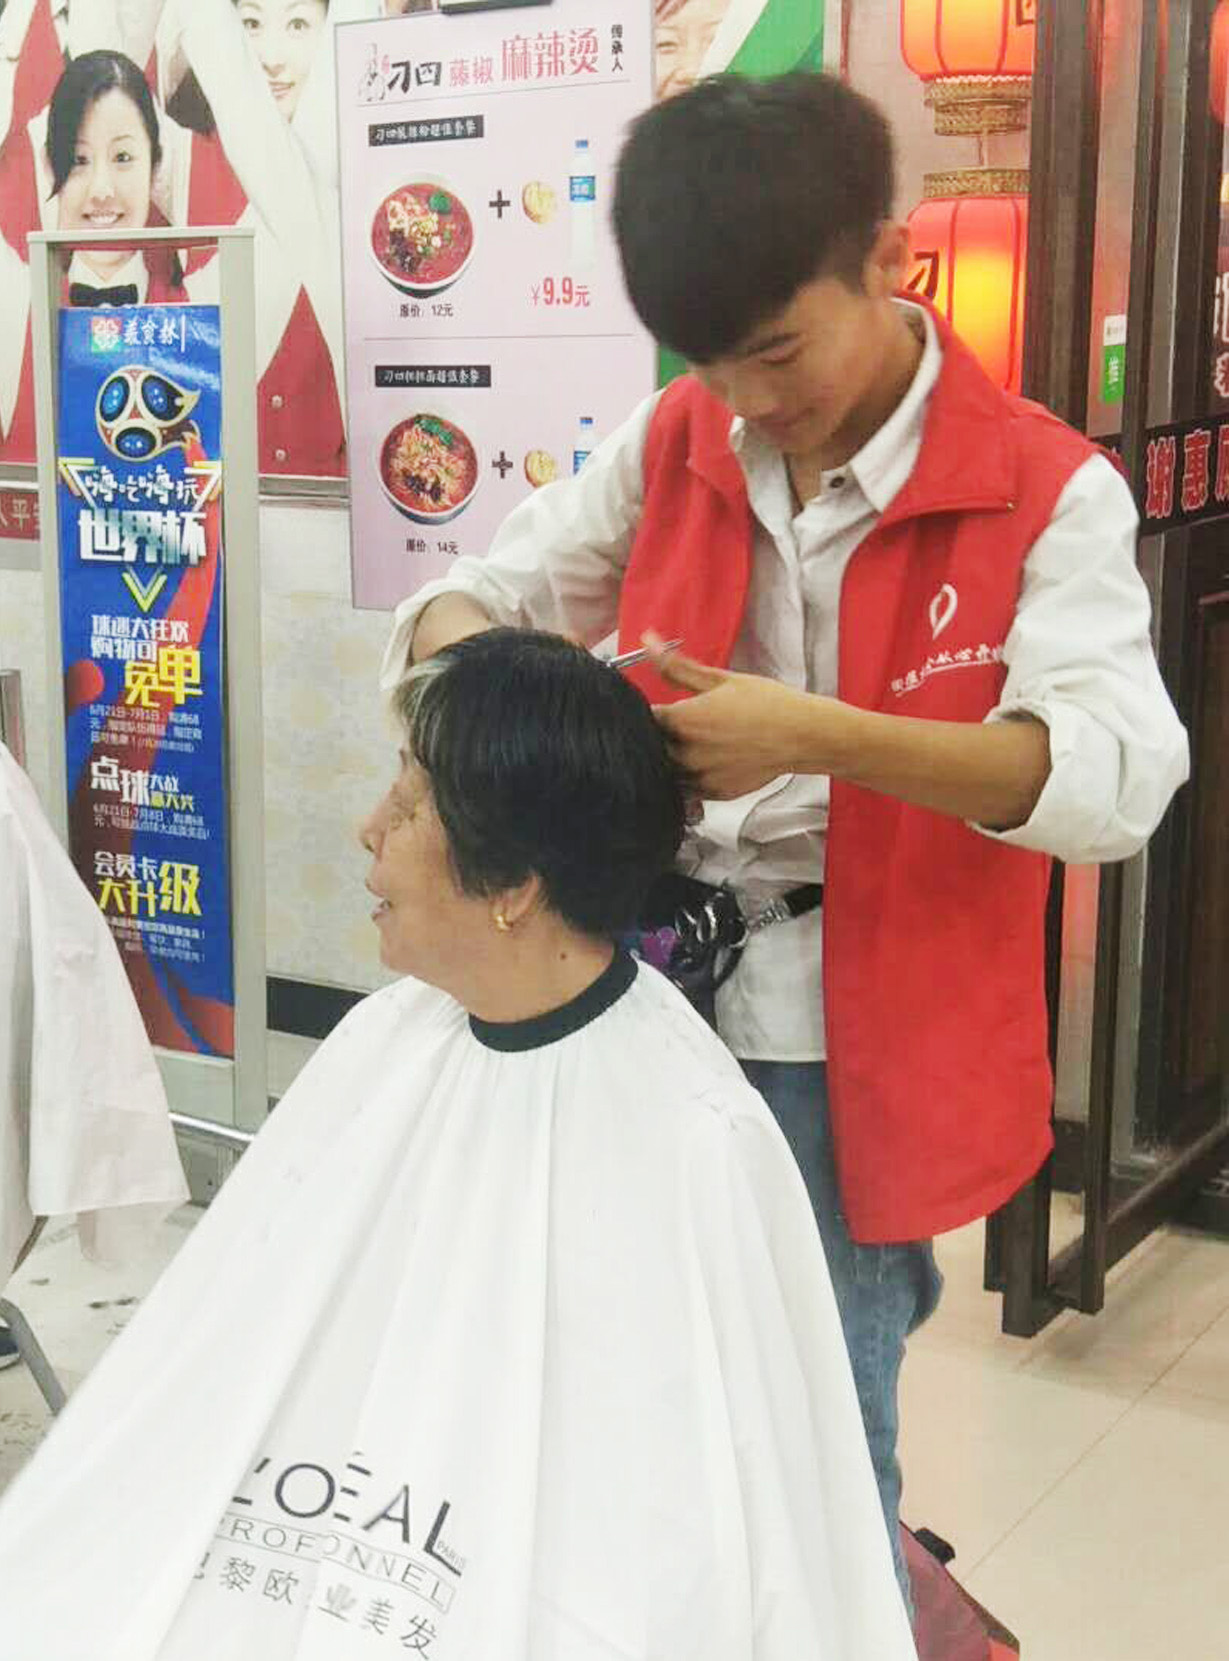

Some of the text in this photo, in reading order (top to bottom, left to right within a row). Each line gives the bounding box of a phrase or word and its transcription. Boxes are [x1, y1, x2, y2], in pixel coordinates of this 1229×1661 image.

[388, 60, 442, 94] 刁四
[502, 27, 599, 81] 麻辣烫
[84, 464, 201, 505] 嗨吃嗨玩
[78, 508, 207, 565] 世界杯
[91, 614, 189, 643] 球迷大狂欢
[91, 635, 203, 708] 购物可 免单
[90, 756, 149, 806] 点球
[94, 850, 158, 880] 会员卡
[98, 860, 202, 917] 大升级
